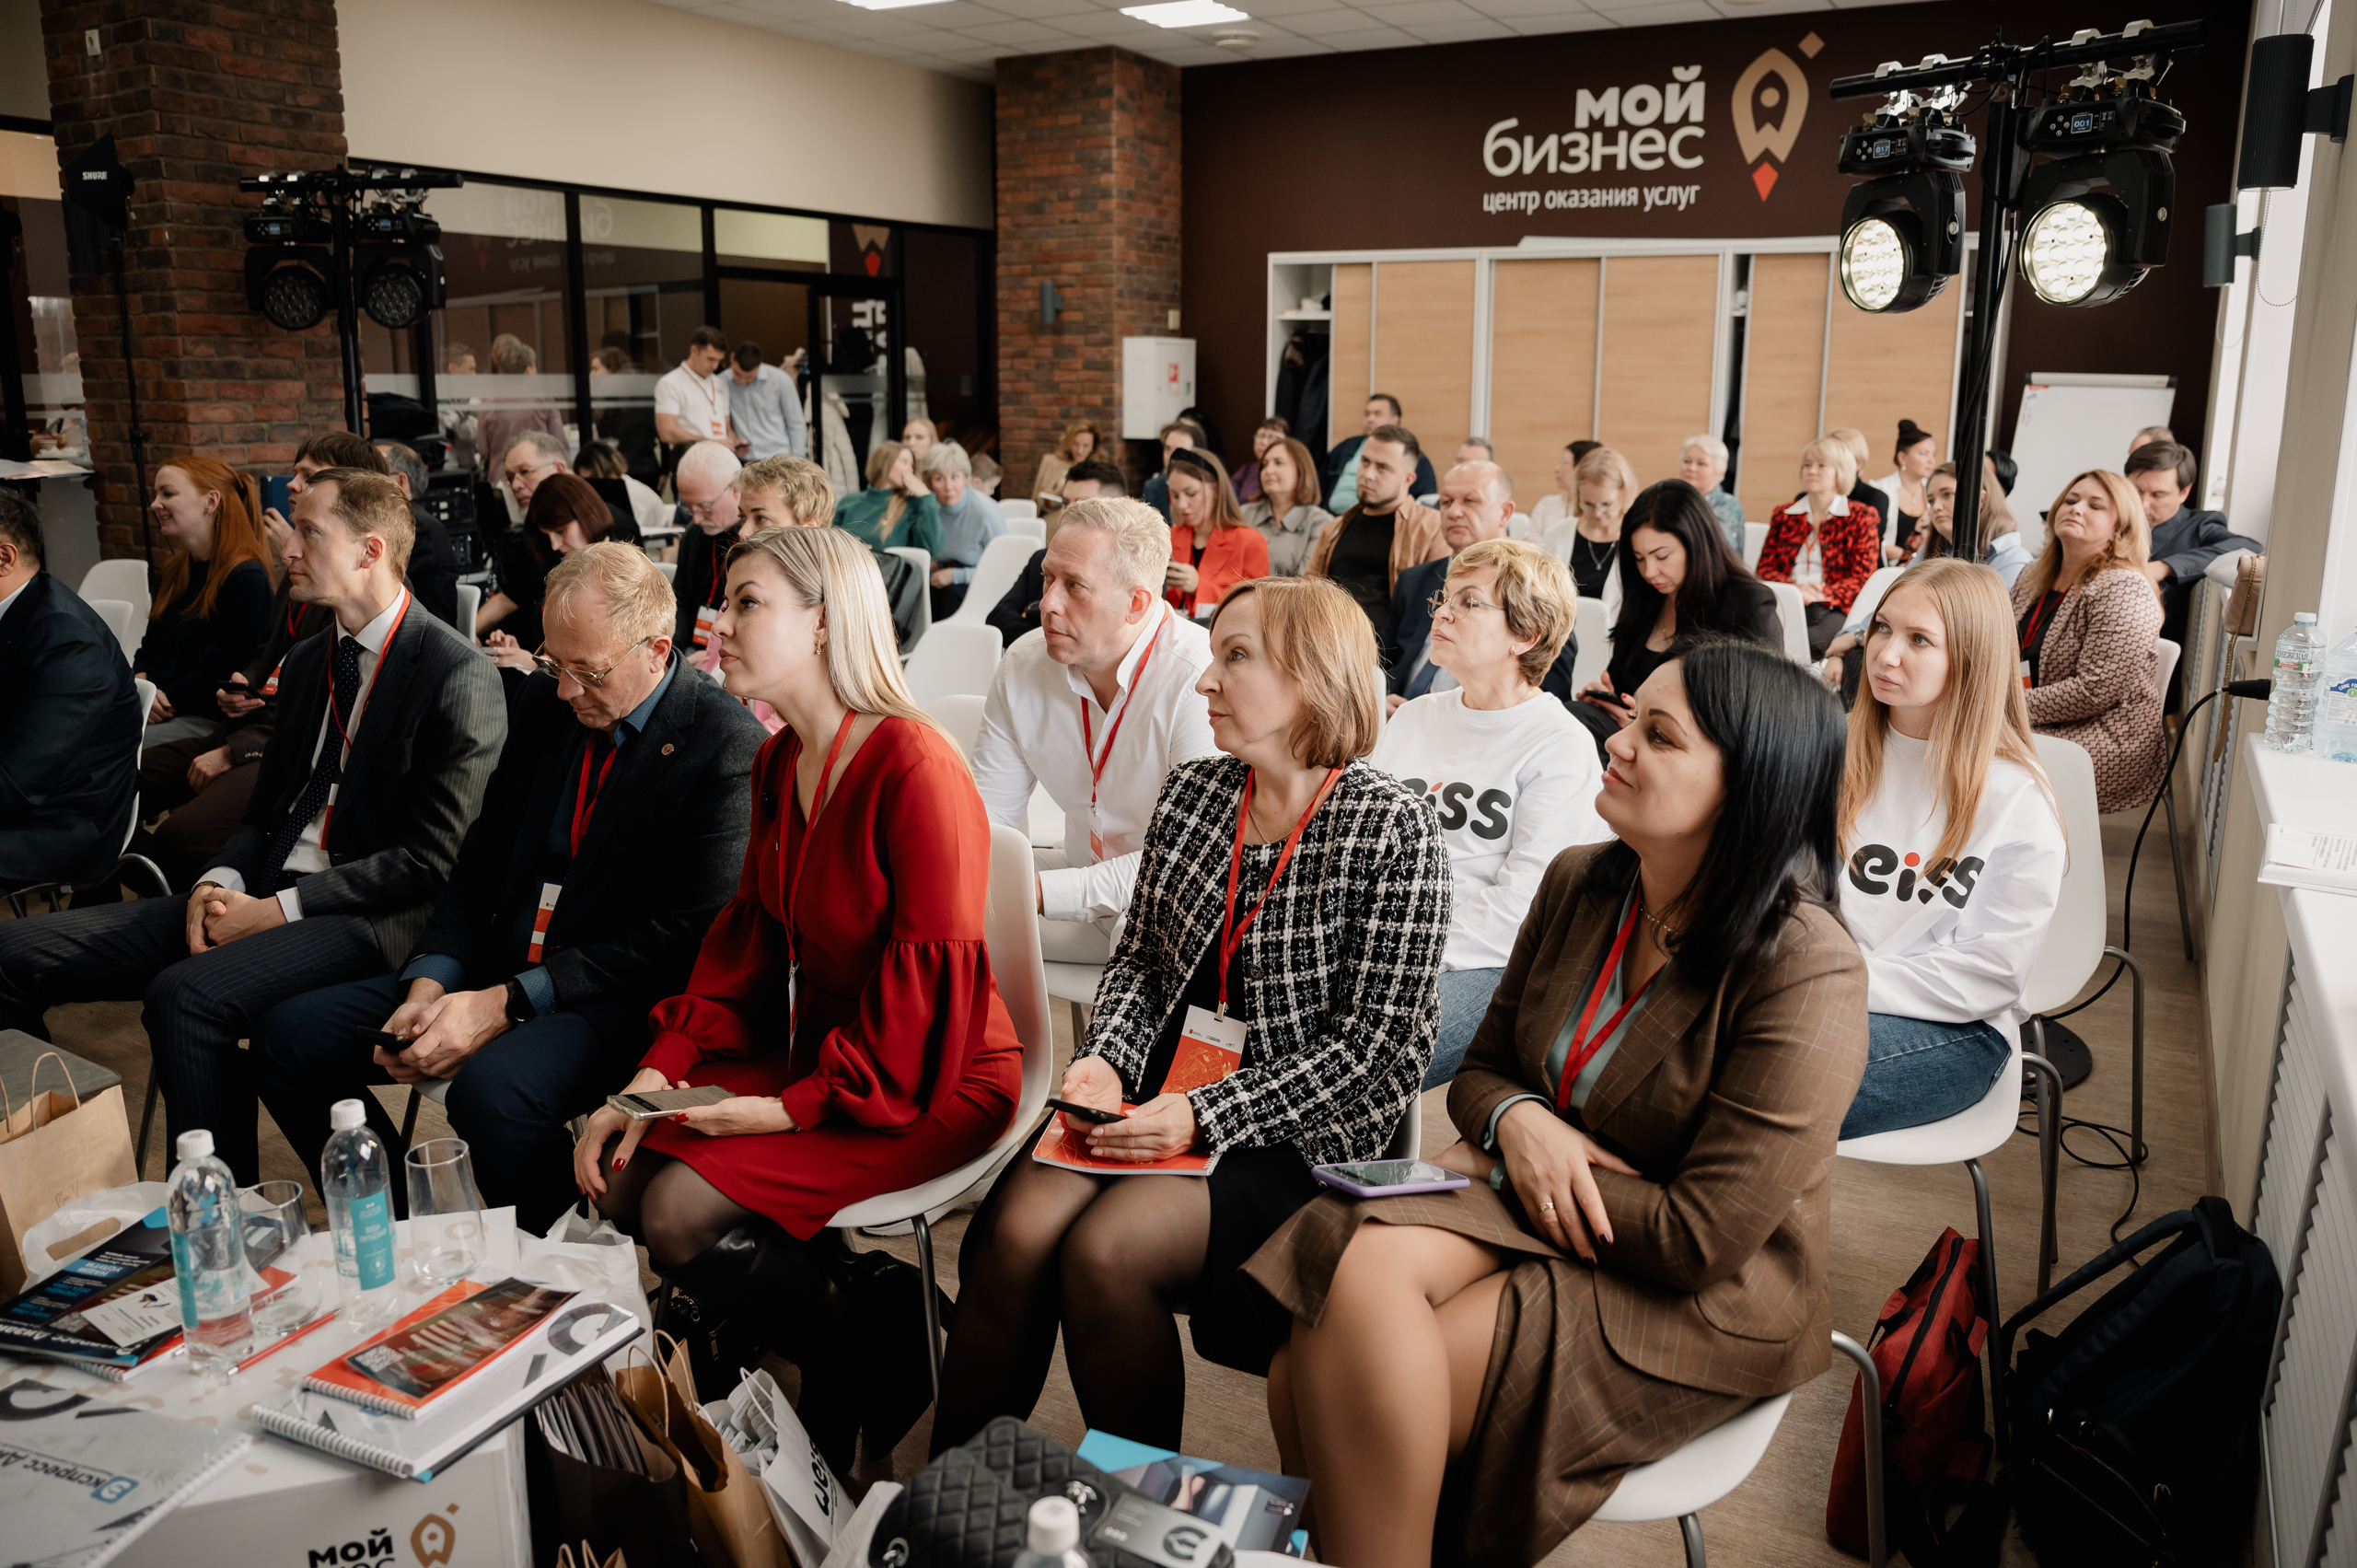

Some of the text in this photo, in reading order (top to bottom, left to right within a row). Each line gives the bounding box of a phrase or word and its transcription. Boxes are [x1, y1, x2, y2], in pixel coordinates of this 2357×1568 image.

[1574, 64, 1706, 128] мой
[1483, 117, 1706, 177] бизнес
[82, 171, 108, 180] SHURE
[1482, 184, 1701, 216] центр оказания услуг
[2275, 649, 2309, 661] ЕНЕЖСКАЯ
[308, 1527, 393, 1568] мой
